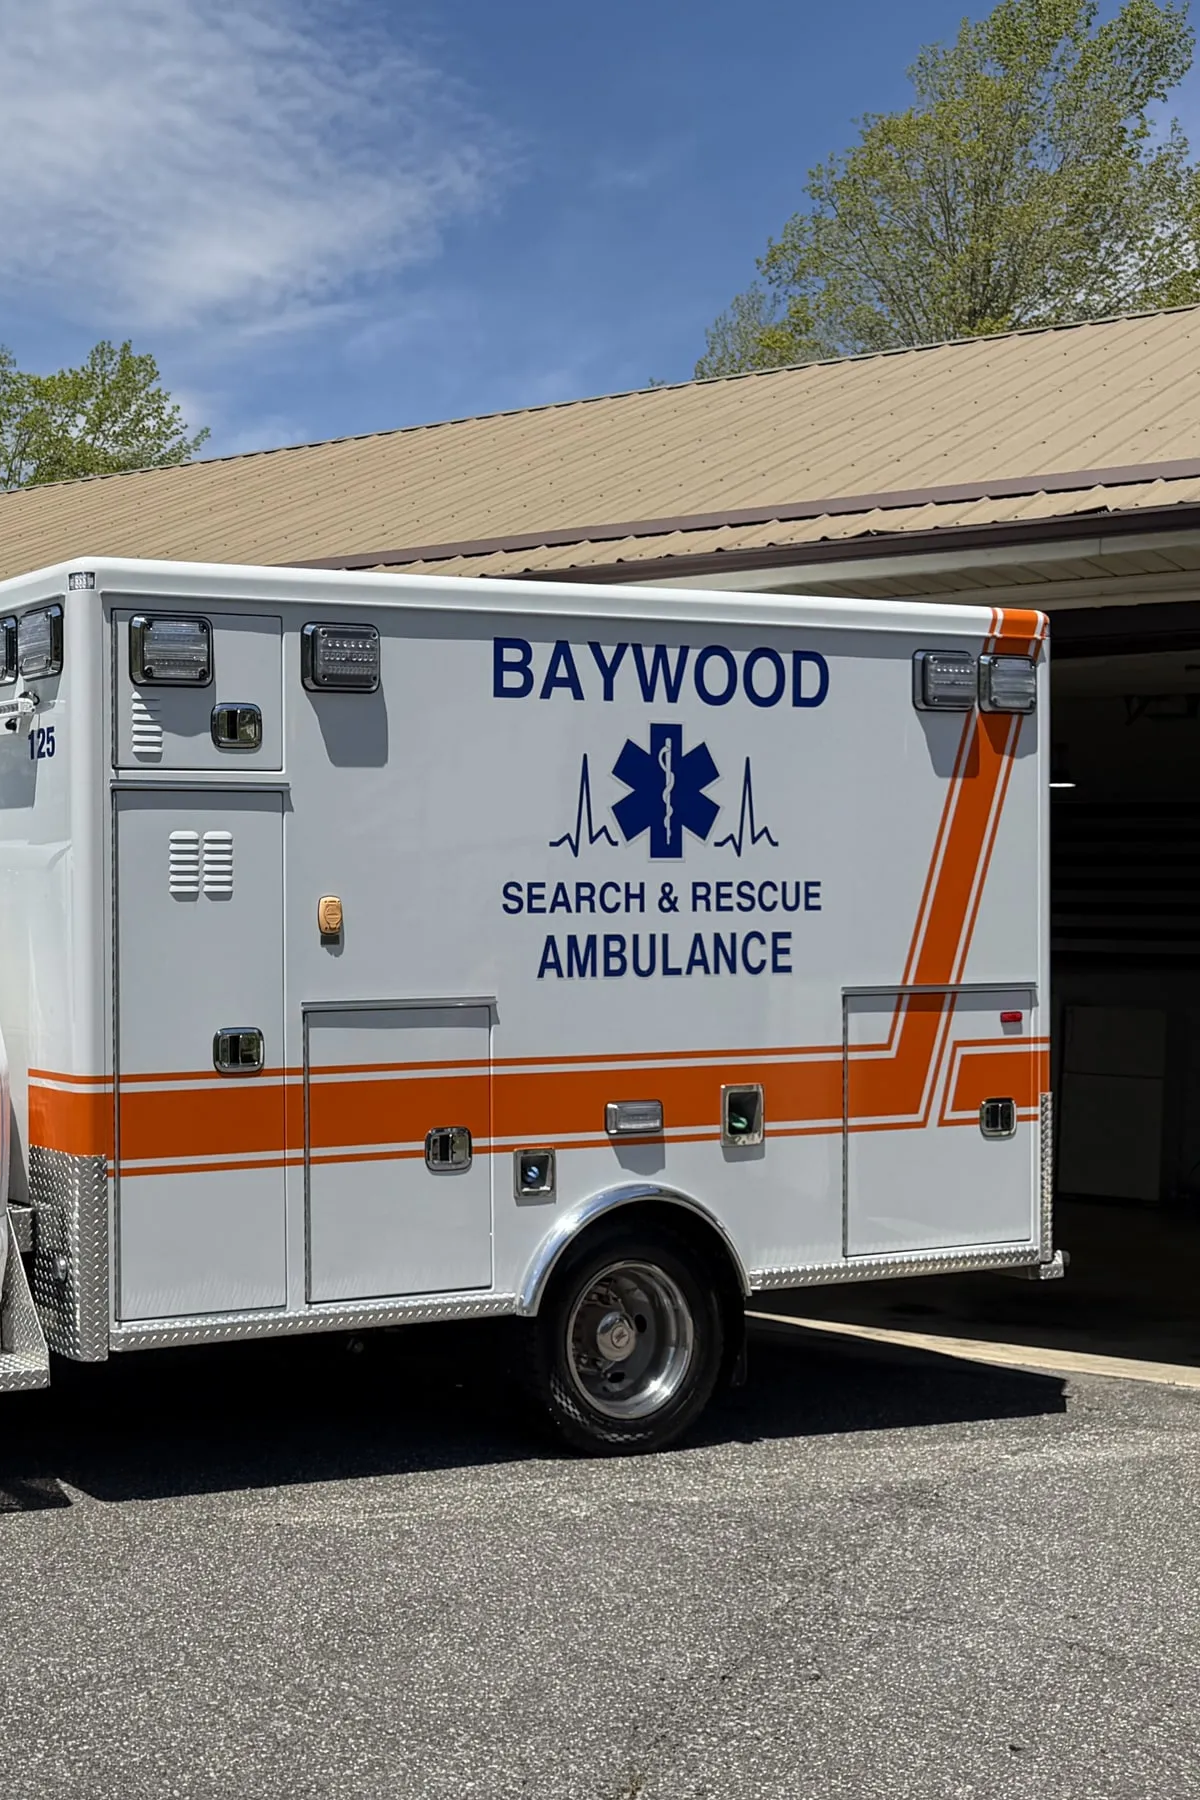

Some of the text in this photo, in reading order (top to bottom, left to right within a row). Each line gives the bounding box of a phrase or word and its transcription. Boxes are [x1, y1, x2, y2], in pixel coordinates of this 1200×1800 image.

[493, 635, 830, 708] BAYWOOD
[28, 726, 55, 760] 125
[503, 880, 822, 914] SEARCH & RESCUE
[537, 931, 793, 978] AMBULANCE
